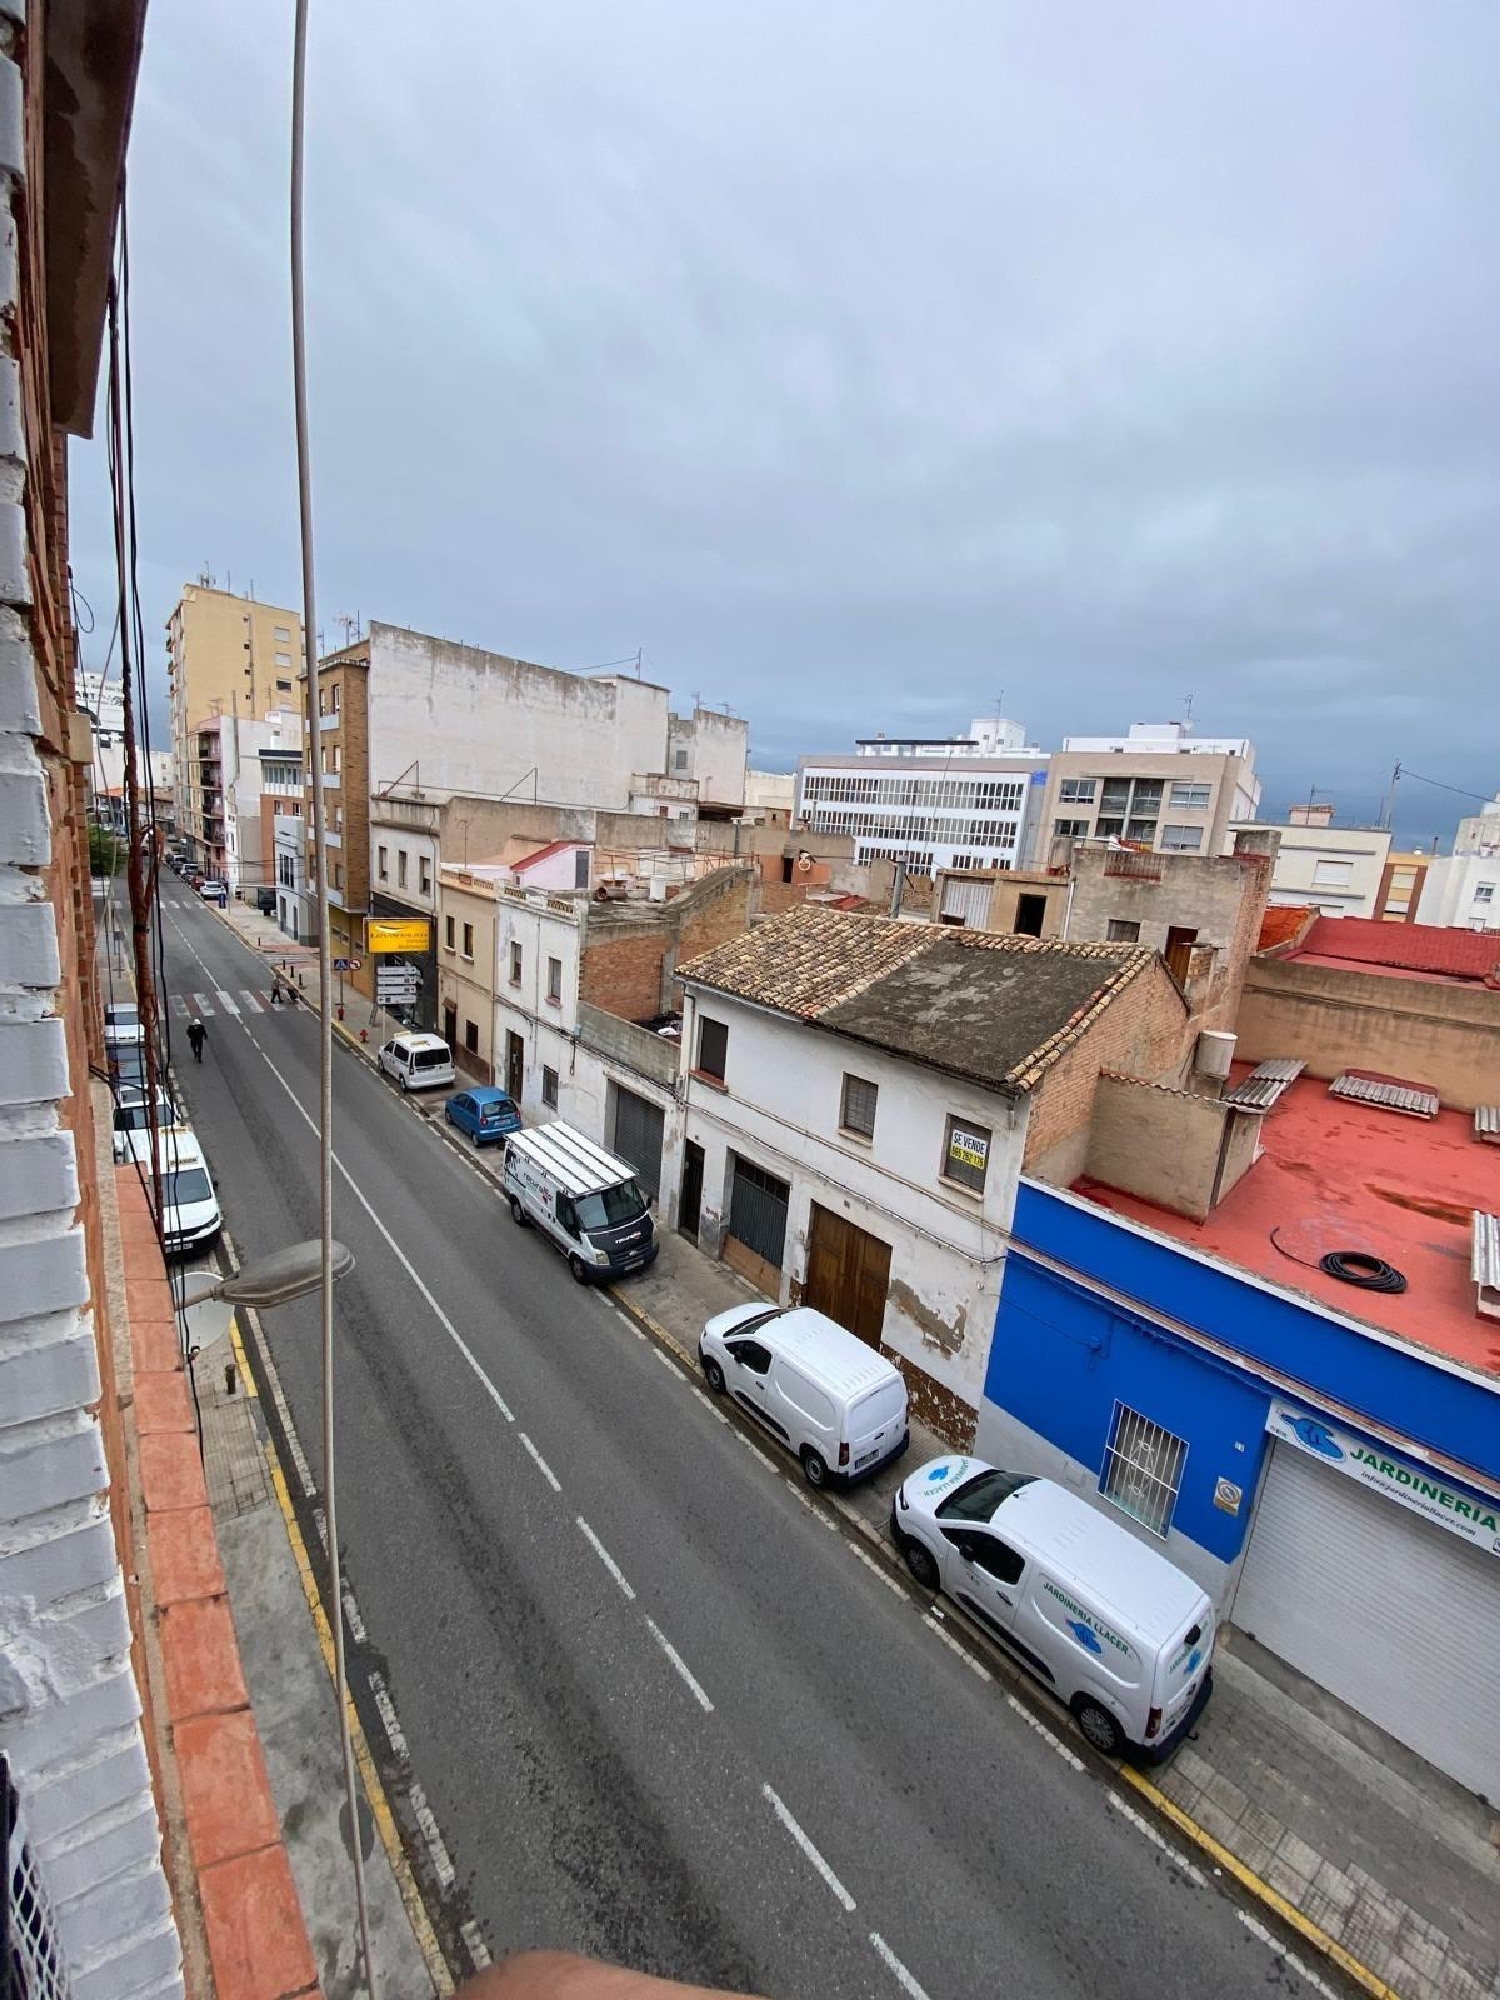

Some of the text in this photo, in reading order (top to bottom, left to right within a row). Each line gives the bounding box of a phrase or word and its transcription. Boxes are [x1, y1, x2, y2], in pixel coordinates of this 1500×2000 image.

[954, 1132, 986, 1155] SE VENDE
[1093, 1622, 1130, 1656] LLACER
